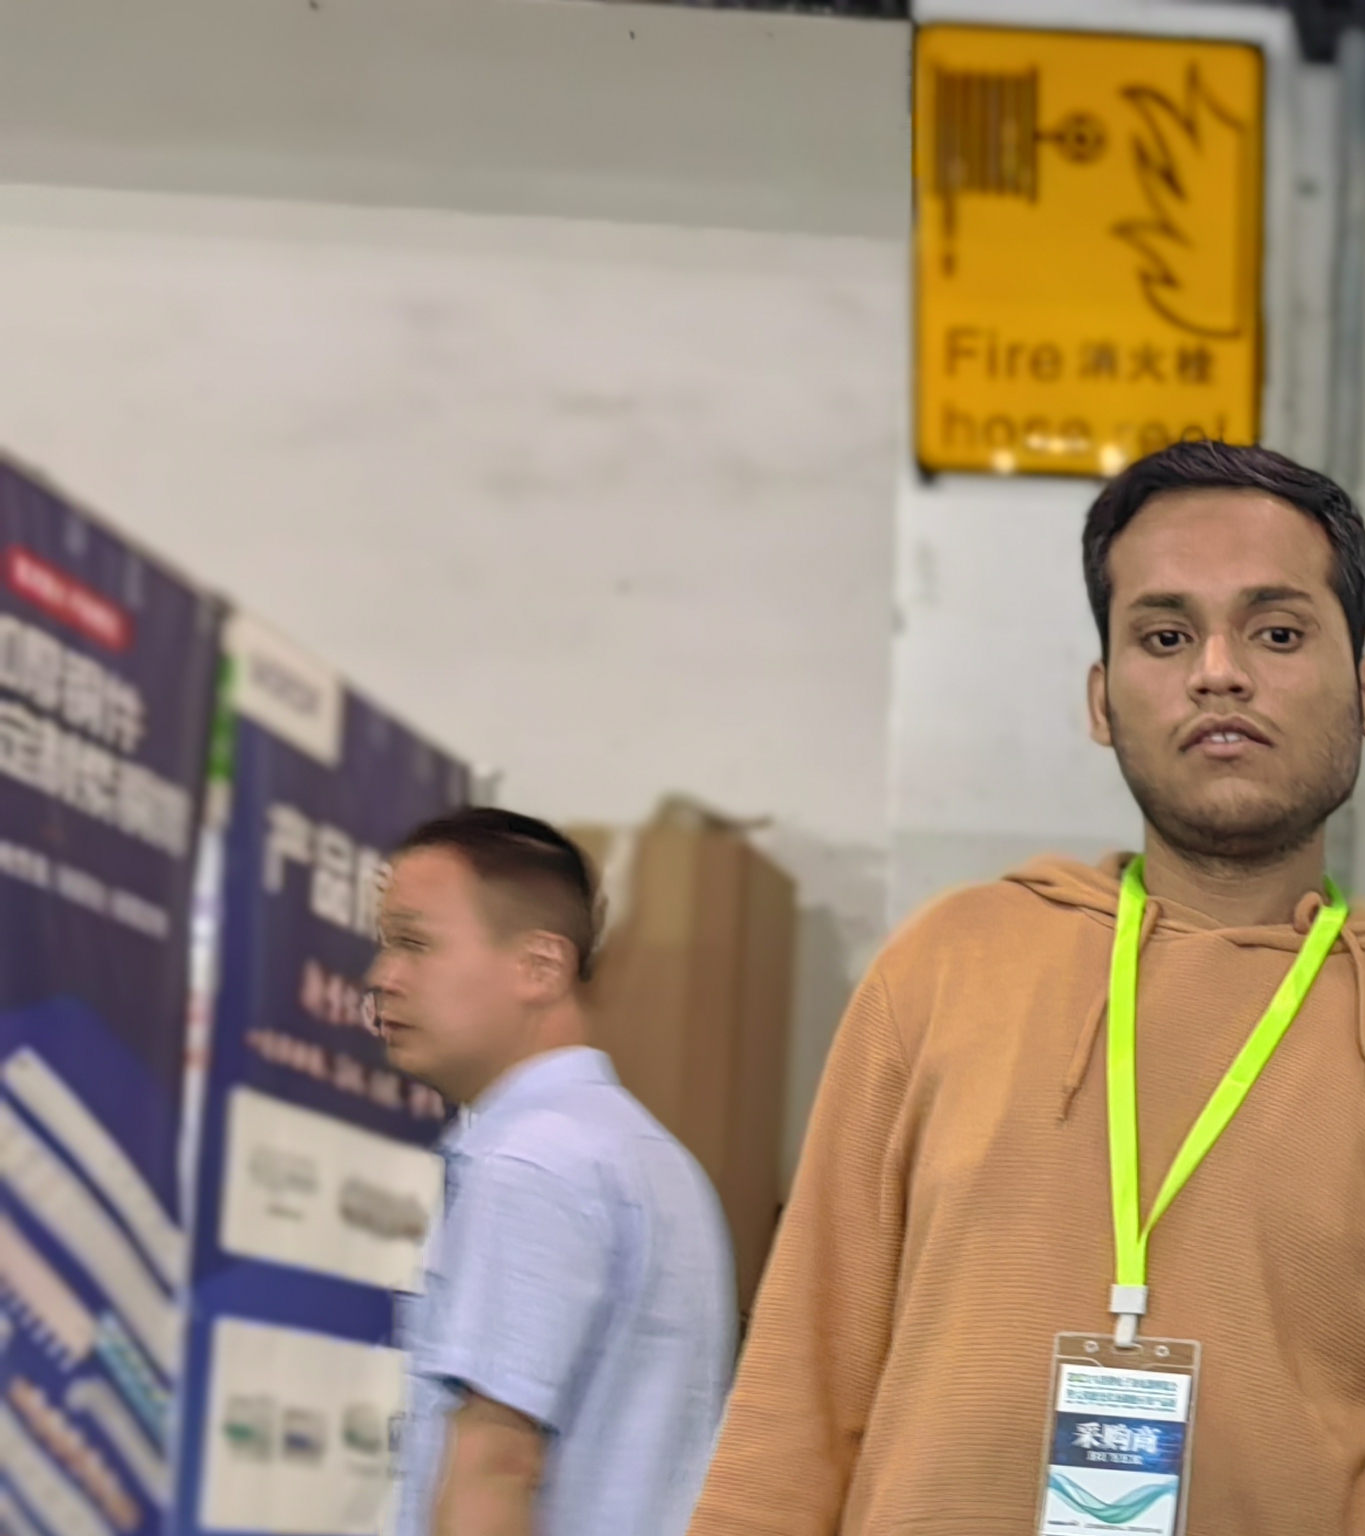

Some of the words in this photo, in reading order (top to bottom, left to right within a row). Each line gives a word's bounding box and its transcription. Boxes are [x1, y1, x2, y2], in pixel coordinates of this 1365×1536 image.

[944, 327, 1063, 383] Fire
[1078, 341, 1214, 386] 消火栓
[1071, 1421, 1162, 1455] 采购商
